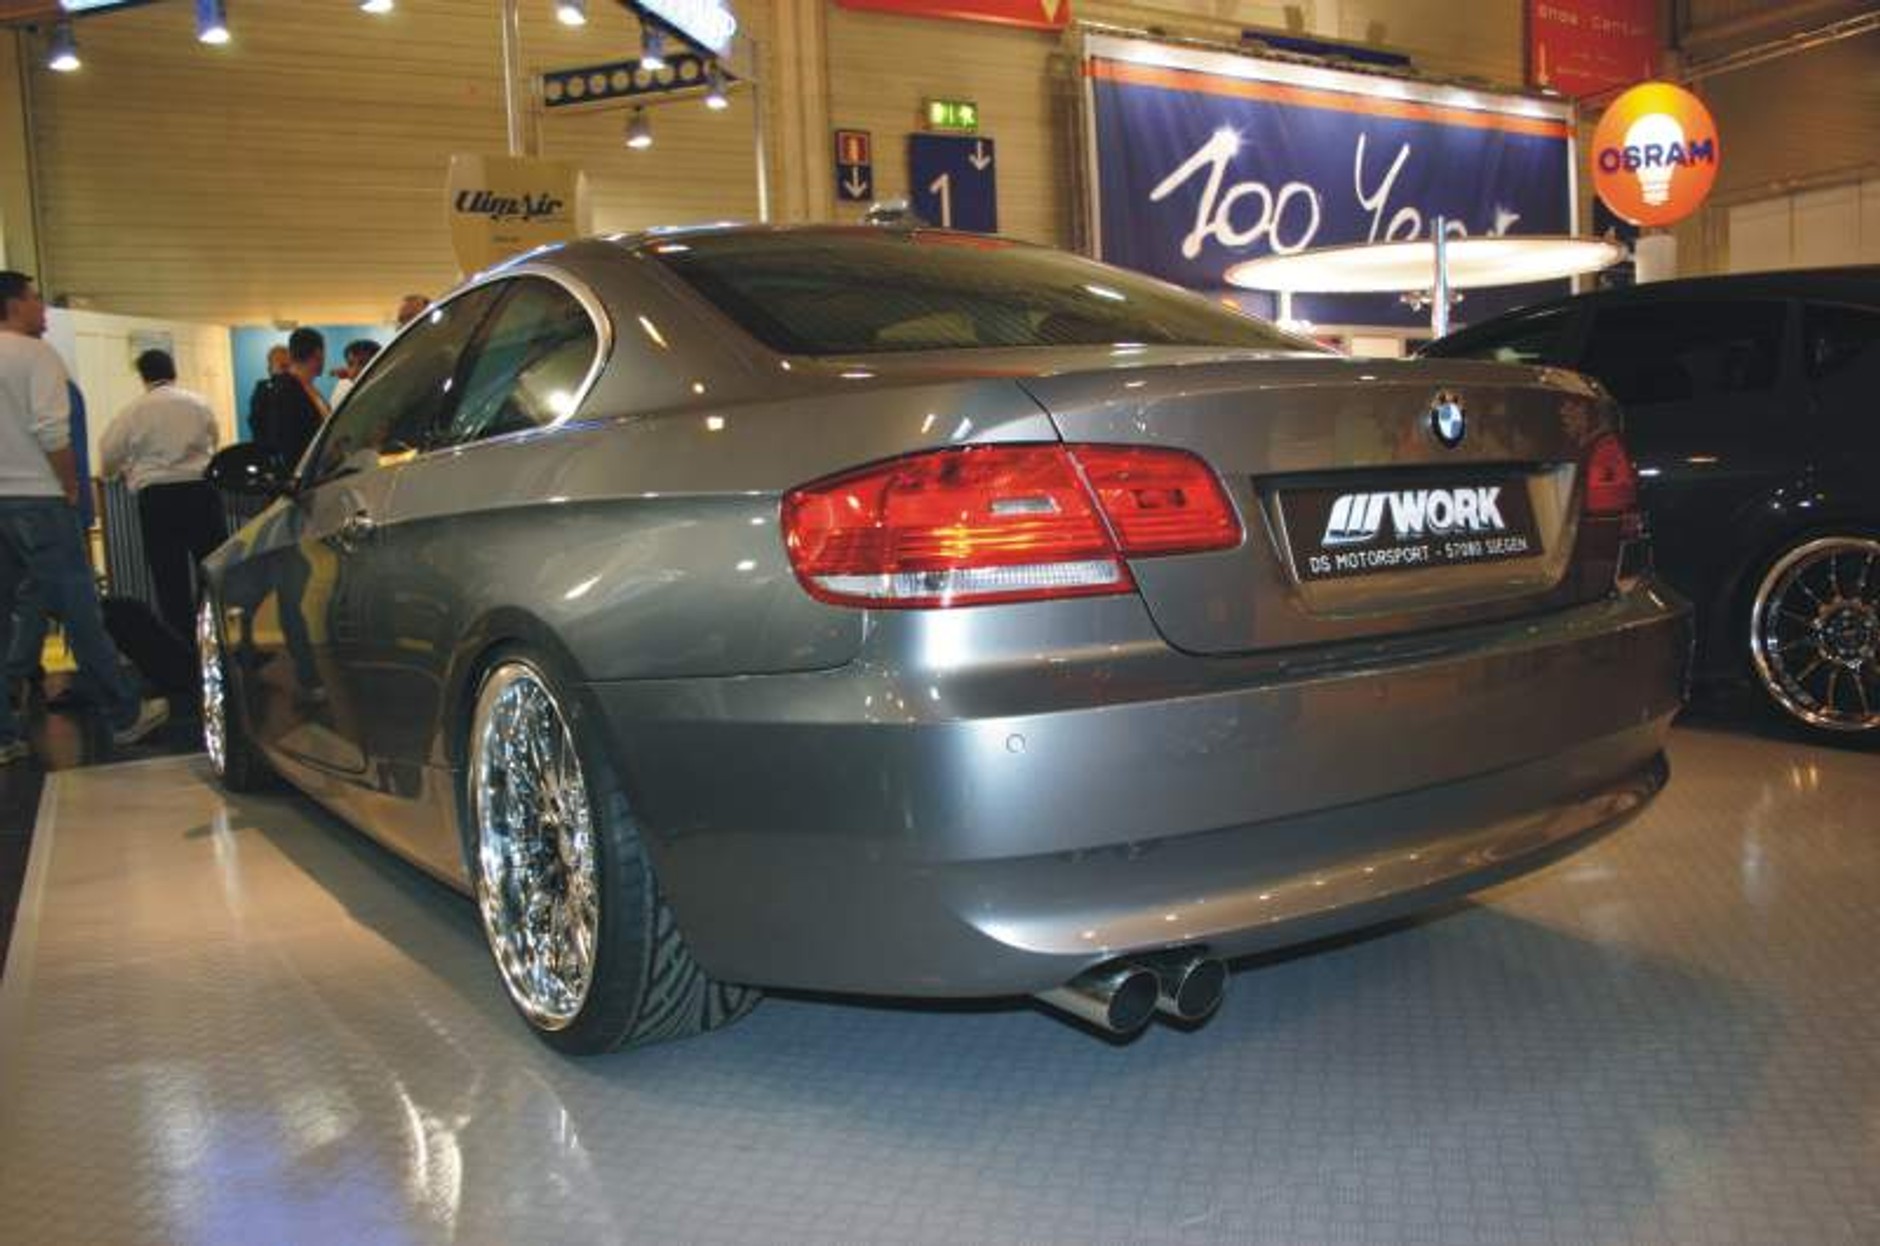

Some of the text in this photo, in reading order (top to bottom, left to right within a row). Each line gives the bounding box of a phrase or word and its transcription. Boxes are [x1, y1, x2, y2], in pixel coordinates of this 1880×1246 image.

[1598, 138, 1714, 175] OSRAM
[929, 172, 951, 228] 1
[1149, 127, 1320, 260] 100
[1386, 486, 1506, 536] WORK
[1308, 555, 1333, 574] DS
[1336, 545, 1430, 572] MOTORSPORT
